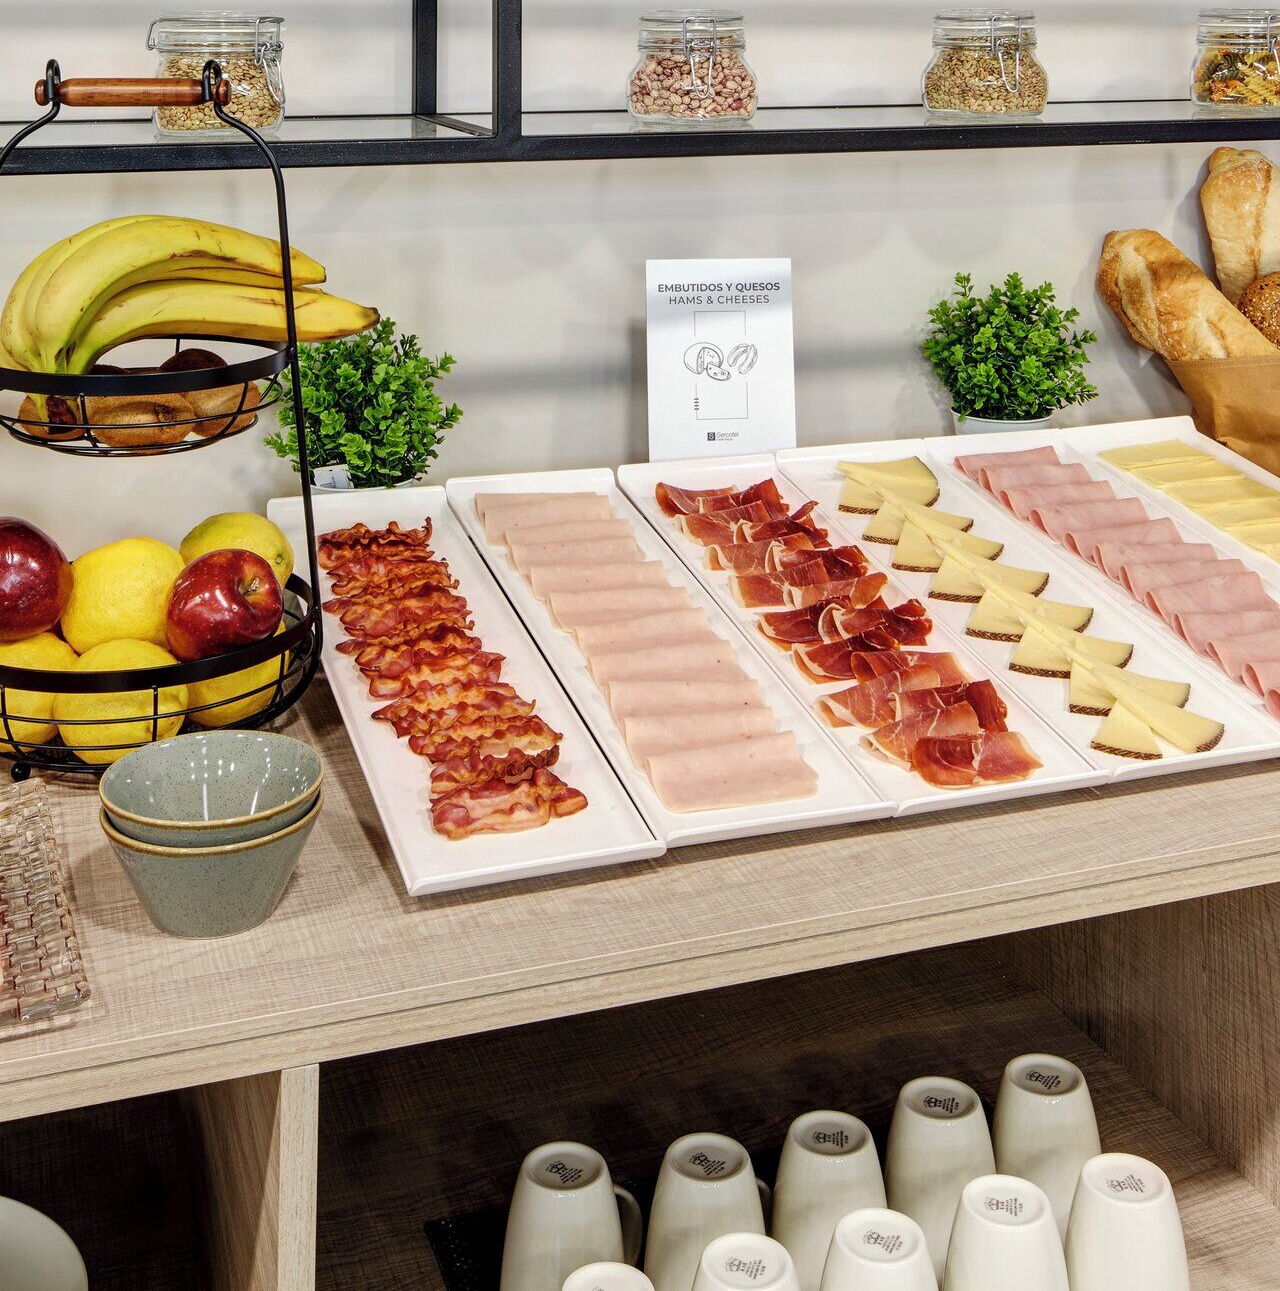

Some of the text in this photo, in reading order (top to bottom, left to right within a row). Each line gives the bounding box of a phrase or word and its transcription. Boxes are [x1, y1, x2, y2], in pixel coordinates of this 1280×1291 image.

[658, 282, 780, 292] EMBUTIDOS Y QUESOS
[669, 294, 770, 305] HAMS & CHEESES
